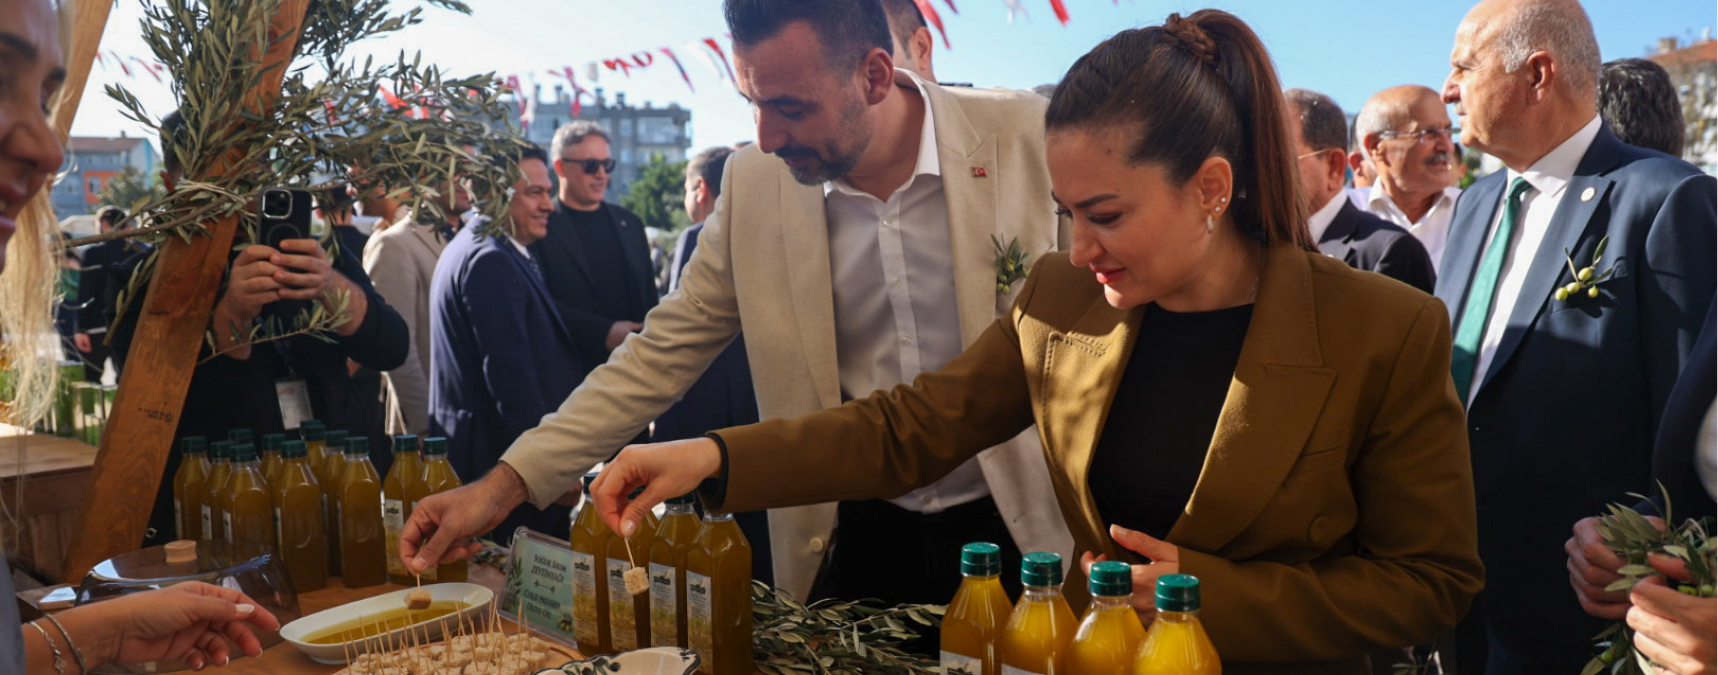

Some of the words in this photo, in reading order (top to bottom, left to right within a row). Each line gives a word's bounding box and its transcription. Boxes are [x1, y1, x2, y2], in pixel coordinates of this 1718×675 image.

[524, 589, 539, 602] COLD
[538, 596, 561, 609] PRESSED
[527, 602, 542, 615] OLIVE
[542, 609, 552, 620] OIL
